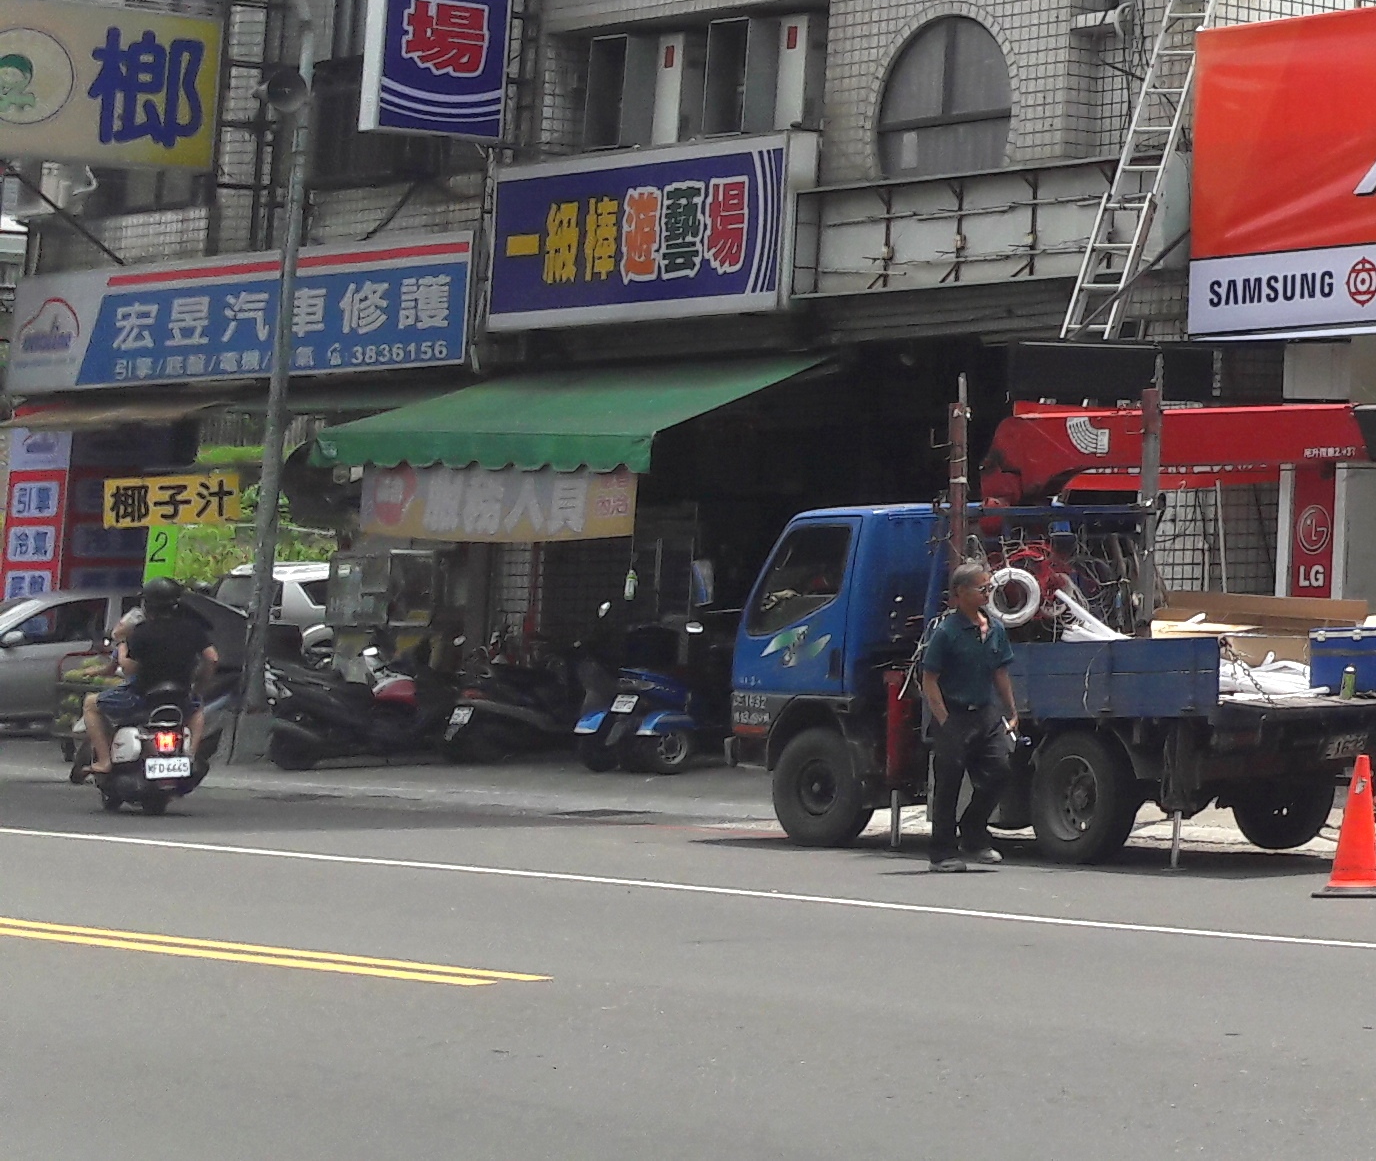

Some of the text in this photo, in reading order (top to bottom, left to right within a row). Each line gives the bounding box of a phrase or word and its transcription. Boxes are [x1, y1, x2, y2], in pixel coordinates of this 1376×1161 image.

[88, 25, 206, 149] 榔
[506, 174, 750, 286] 一級棒遊藝場
[1208, 269, 1334, 308] SAMSUNG
[111, 274, 453, 352] 宏昱汽車修護
[351, 339, 449, 366] 3836156
[109, 478, 235, 525] 椰子汁
[148, 530, 169, 564] 2
[1298, 563, 1325, 588] LG
